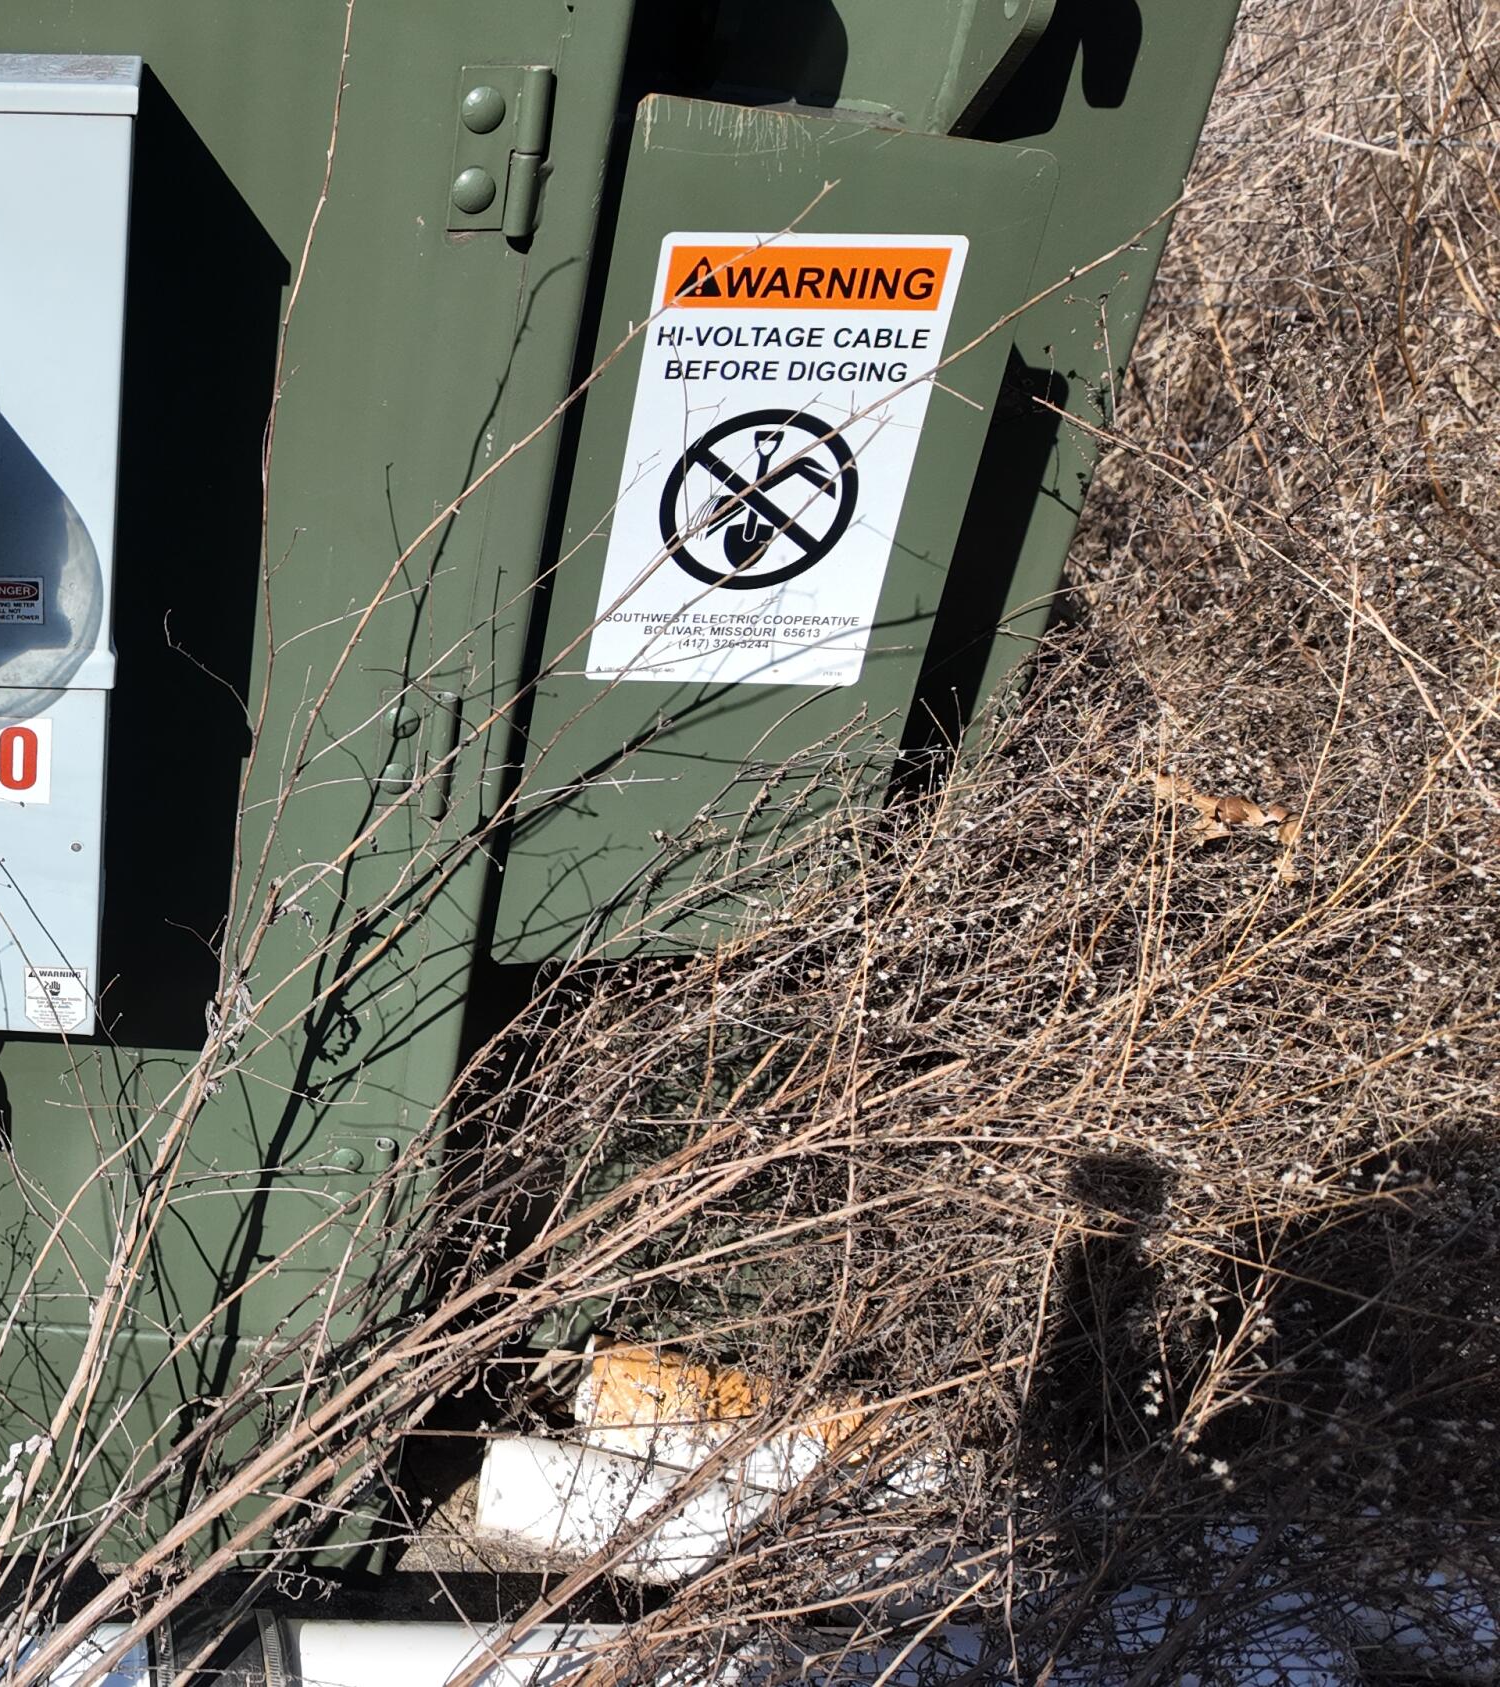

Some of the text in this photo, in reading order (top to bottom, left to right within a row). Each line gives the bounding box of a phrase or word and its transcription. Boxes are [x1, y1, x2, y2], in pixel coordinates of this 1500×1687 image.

[724, 266, 936, 301] WARNING
[657, 325, 931, 350] HI-VOLTAGE CABLE
[663, 359, 908, 383] BEFORE DIGGING
[604, 611, 861, 627] SOUTHWEST ELECTRIC COOPERATIVE
[709, 626, 777, 638] MISSOURI
[782, 627, 821, 639] 65613
[678, 638, 710, 650] (417)
[38, 970, 82, 979] WARNING
